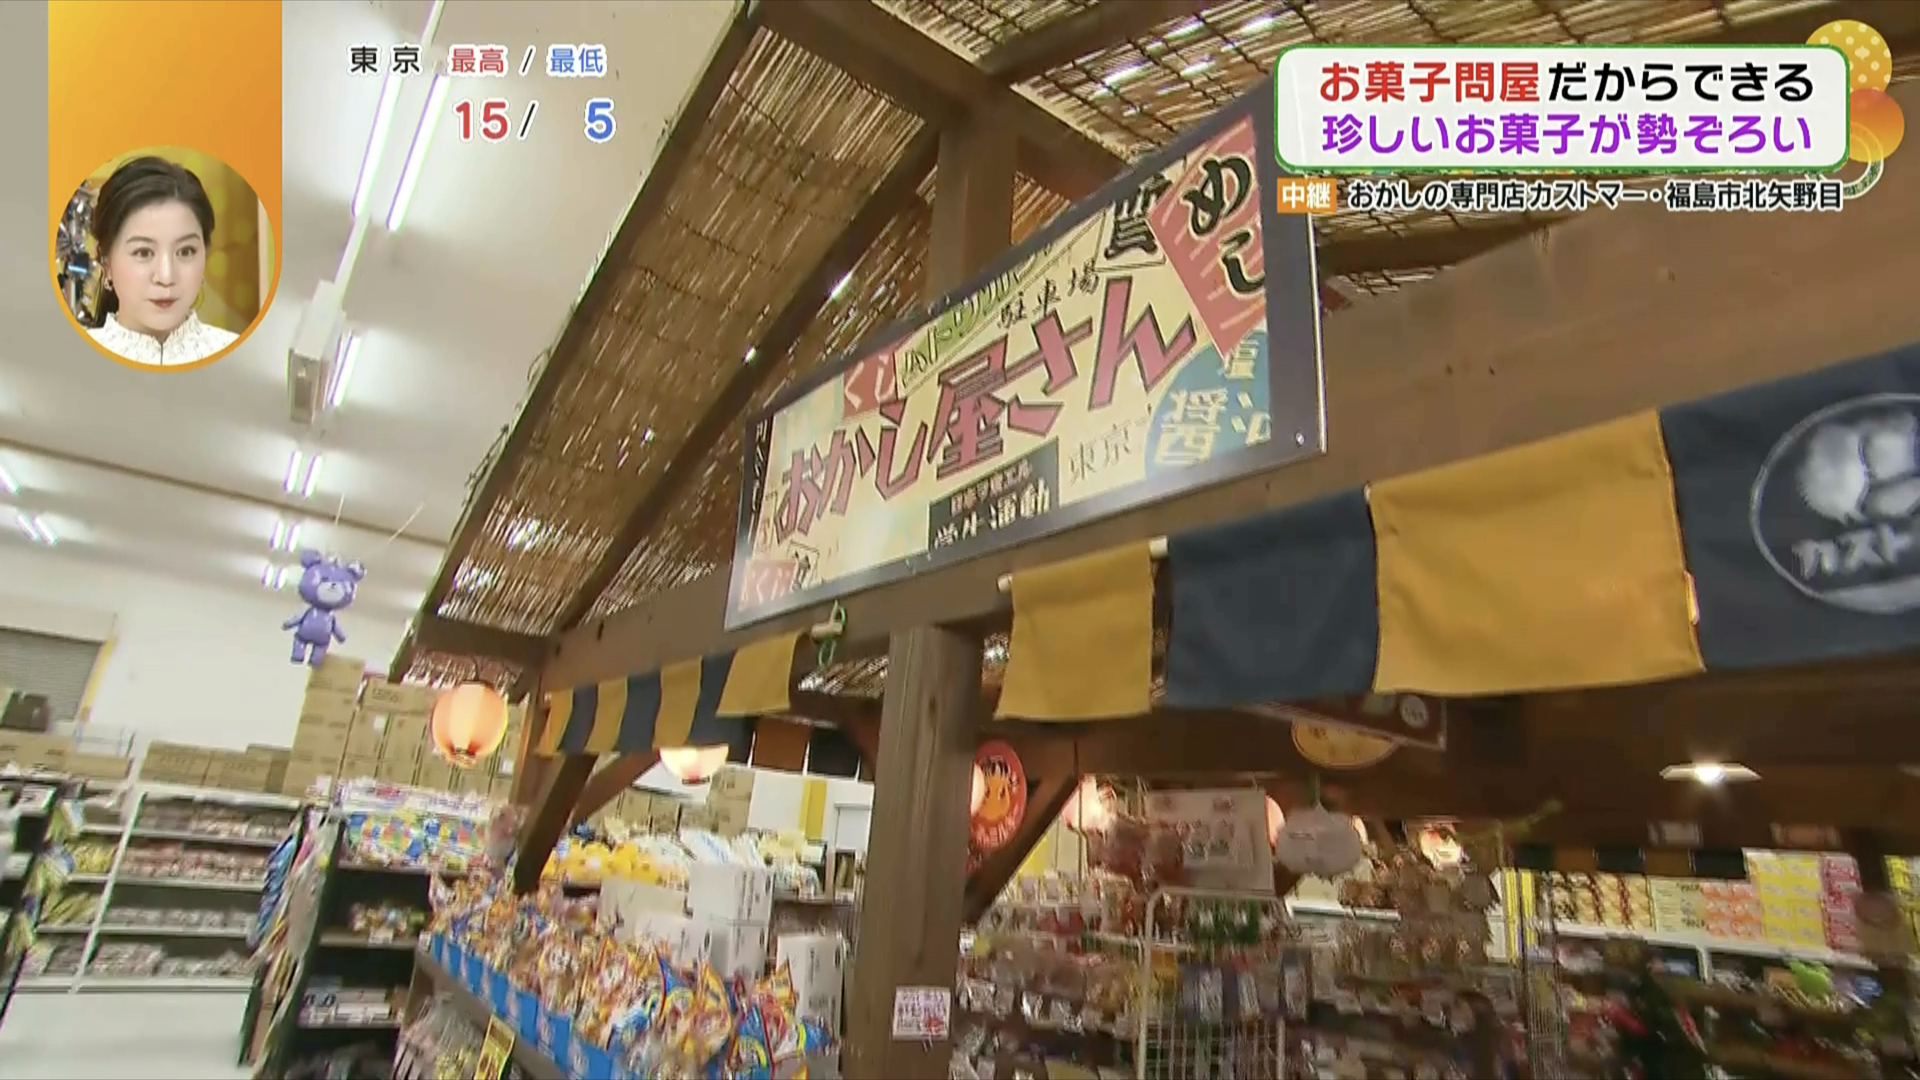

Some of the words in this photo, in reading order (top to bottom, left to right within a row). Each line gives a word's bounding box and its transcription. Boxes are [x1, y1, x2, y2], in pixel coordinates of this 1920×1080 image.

[774, 275, 1197, 542] おかし屋さん
